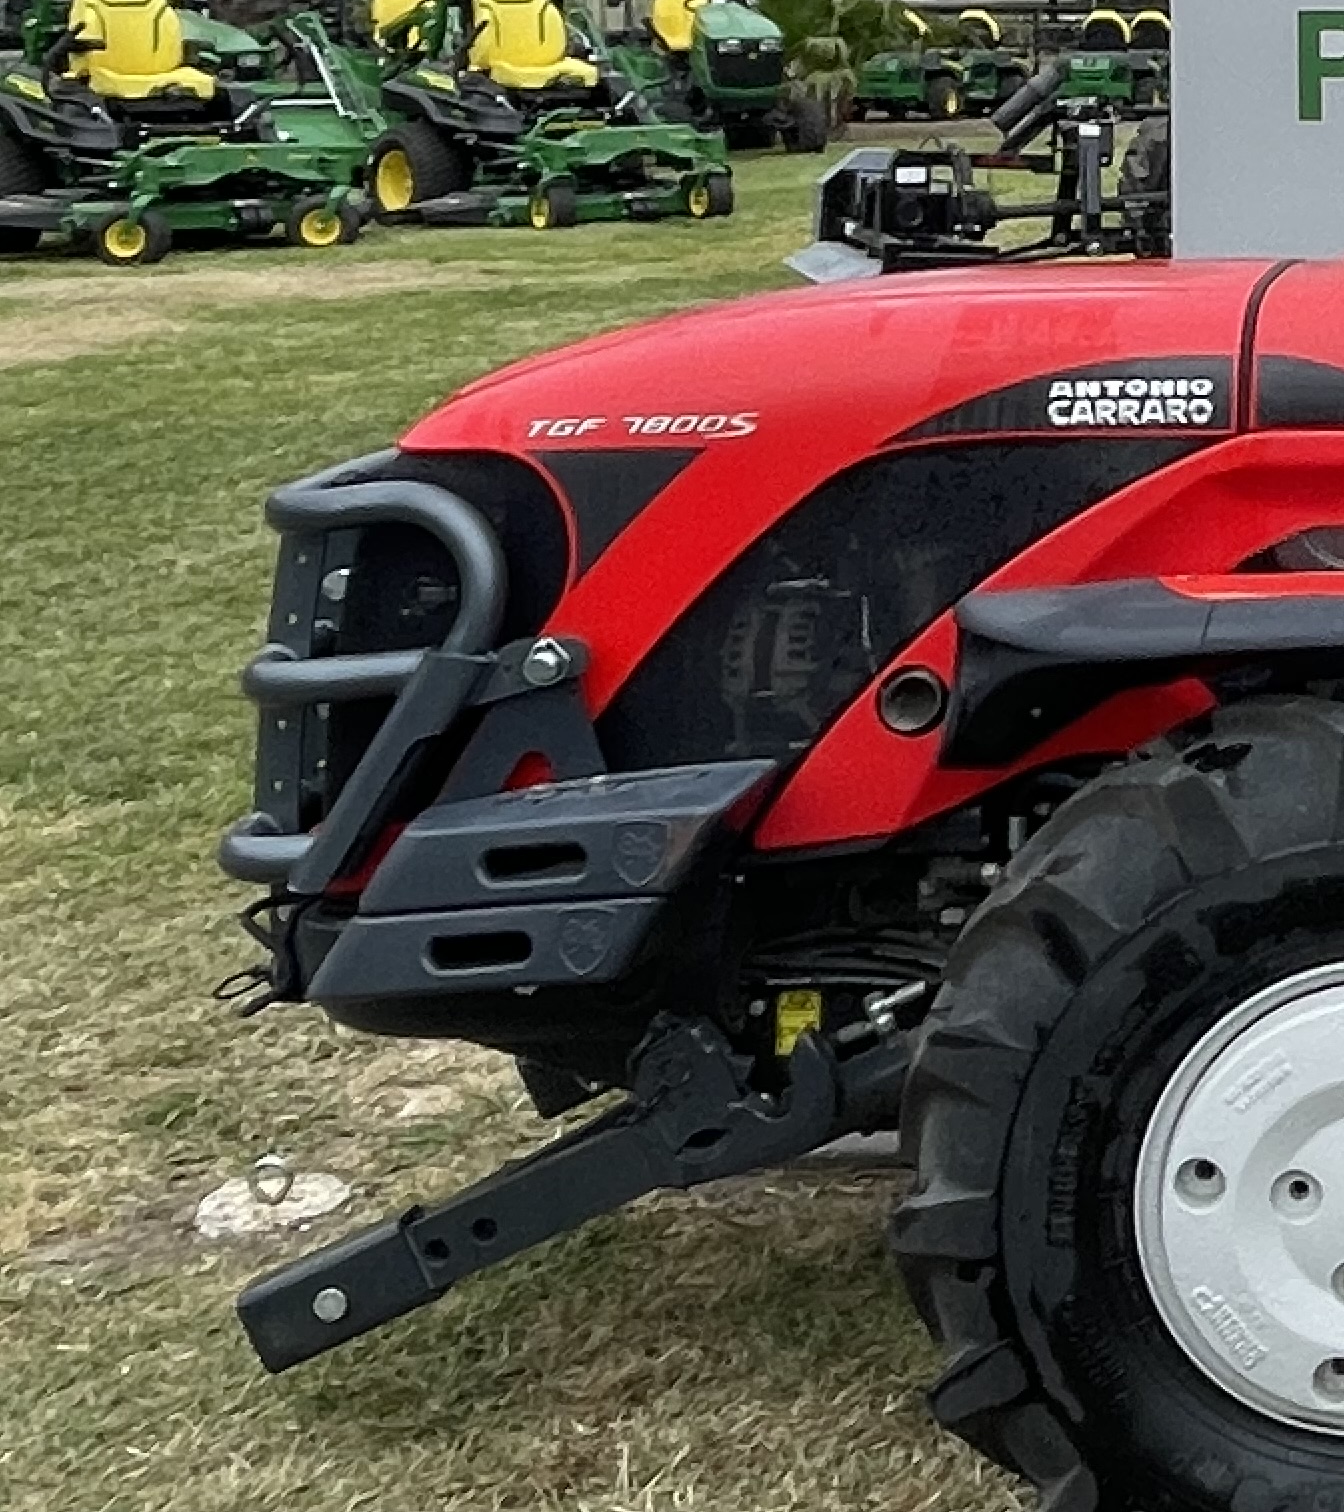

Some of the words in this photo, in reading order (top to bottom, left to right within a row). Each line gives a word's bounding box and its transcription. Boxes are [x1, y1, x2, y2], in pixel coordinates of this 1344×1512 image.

[1048, 378, 1215, 398] ANTONIO
[527, 417, 608, 439] TGF
[621, 412, 761, 440] 7800S
[1047, 398, 1215, 426] CARRARO
